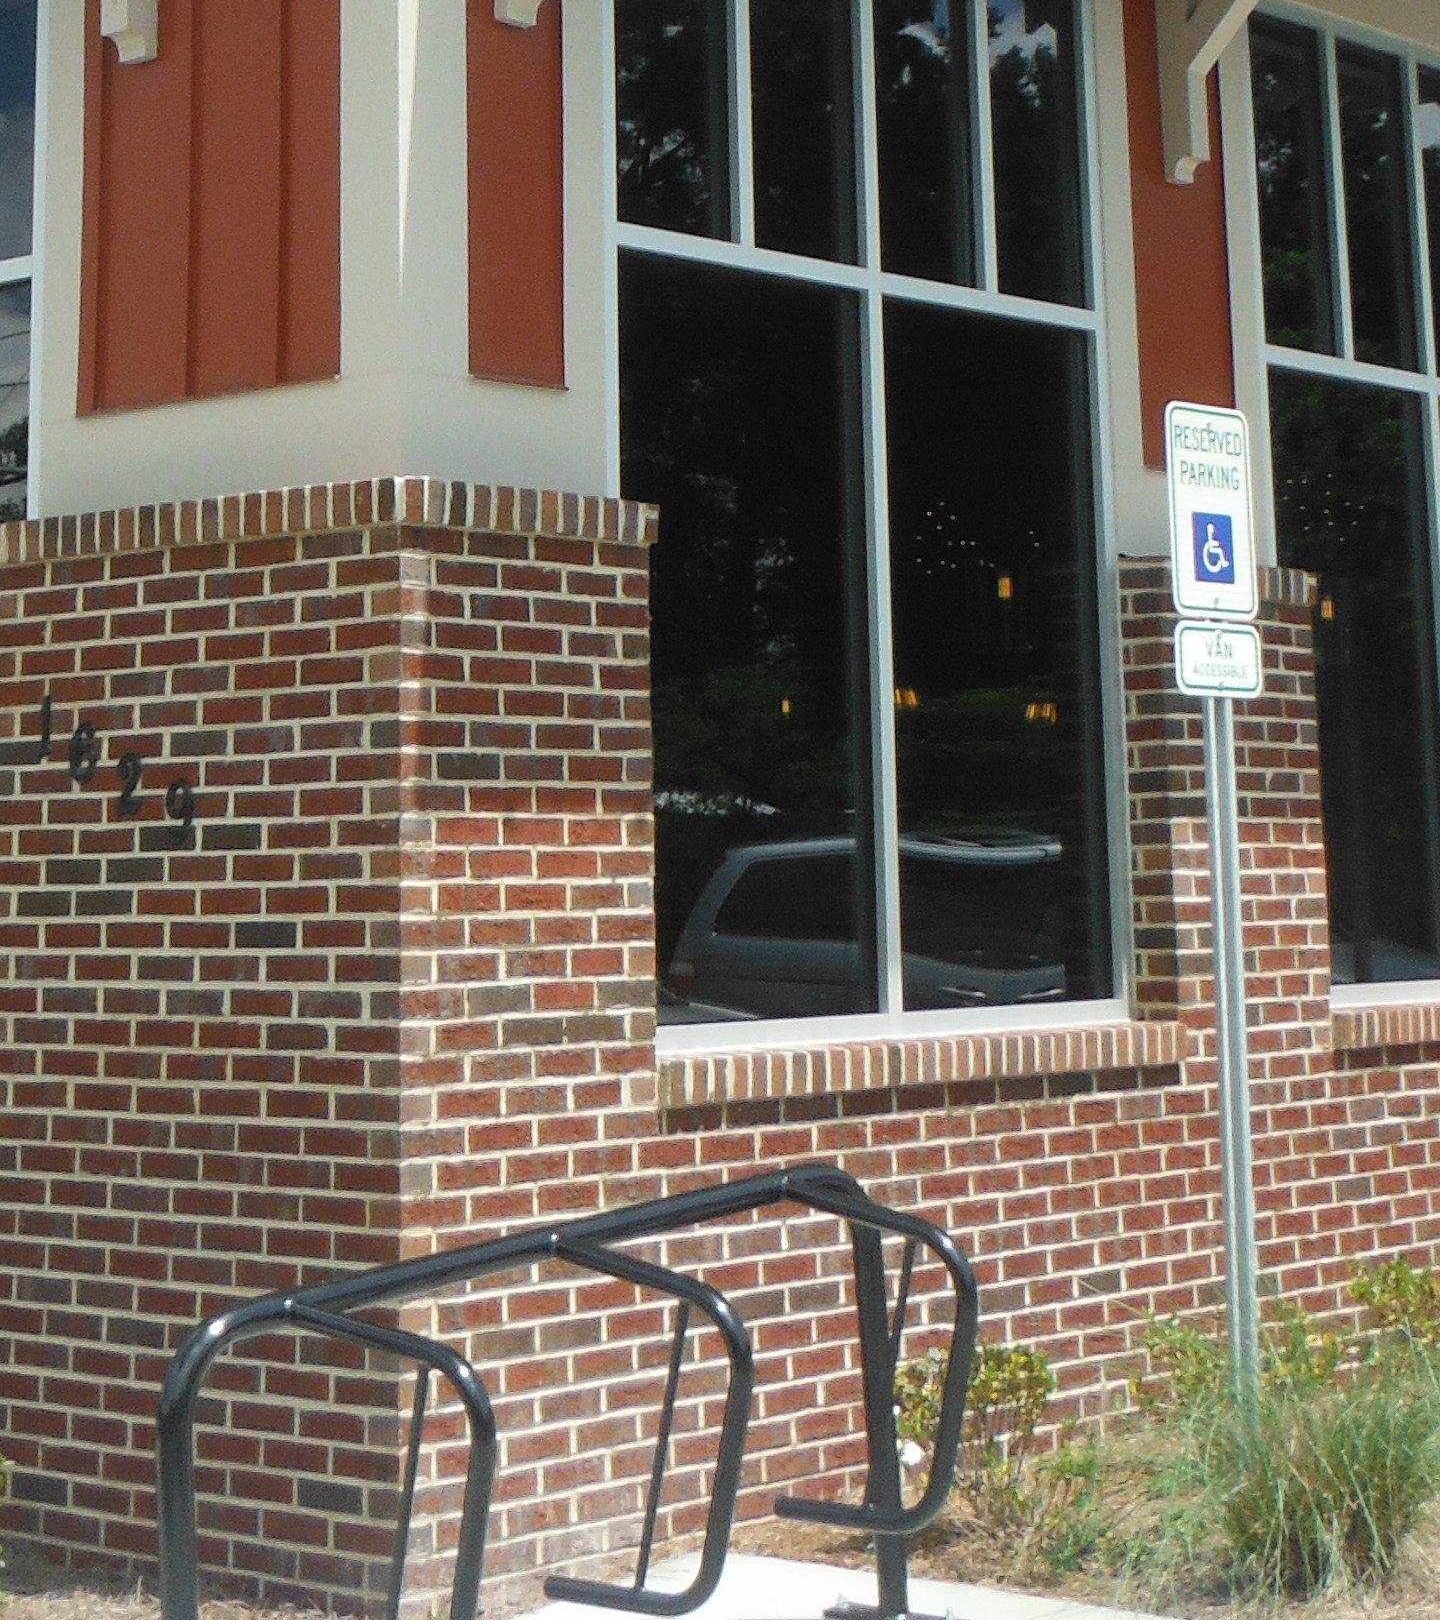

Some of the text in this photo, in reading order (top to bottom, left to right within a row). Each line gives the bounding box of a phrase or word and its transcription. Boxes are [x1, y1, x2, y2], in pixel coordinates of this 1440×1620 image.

[1173, 423, 1242, 458] RESERVED
[1179, 459, 1241, 491] PARKING
[1205, 639, 1234, 660] VAN
